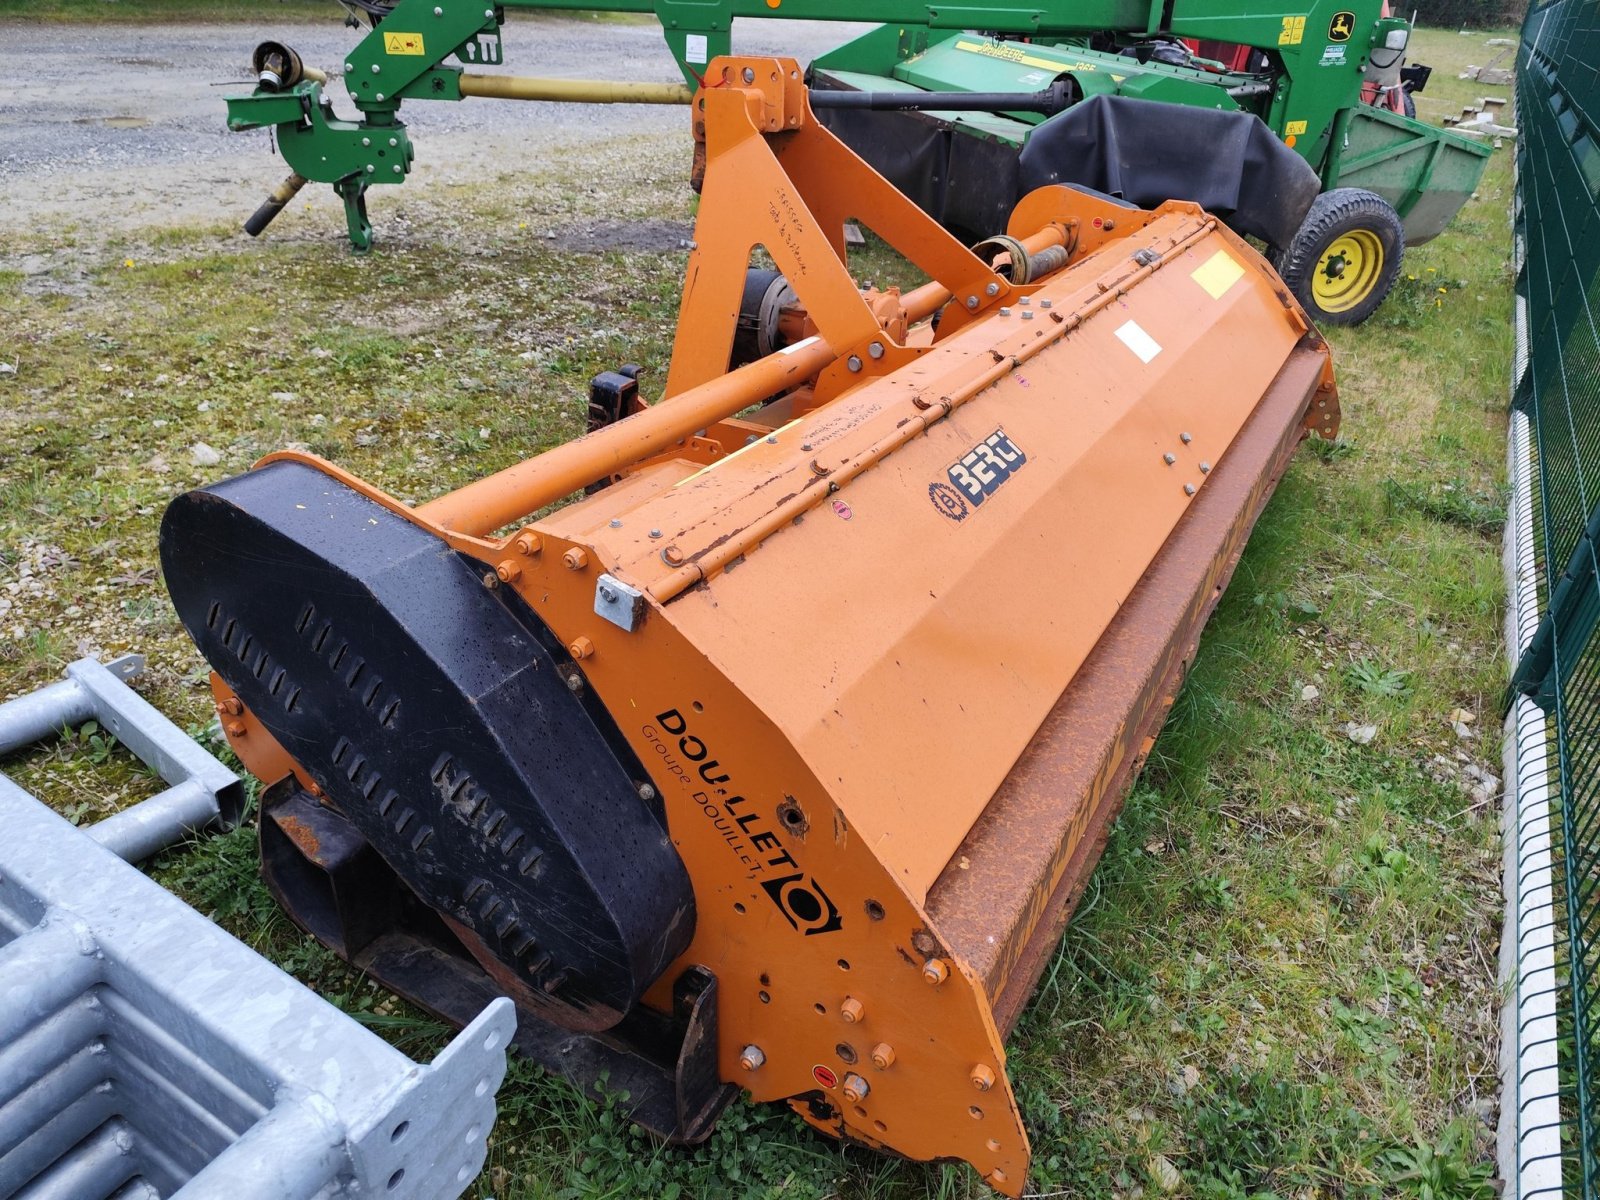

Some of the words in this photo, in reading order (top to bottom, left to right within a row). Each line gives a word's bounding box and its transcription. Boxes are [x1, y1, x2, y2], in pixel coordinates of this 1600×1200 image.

[999, 44, 1025, 62] DEERE
[947, 429, 1026, 507] BERTI
[642, 724, 691, 784] Groupe
[692, 791, 765, 873] DOUILLET
[656, 708, 798, 869] DOULLET
